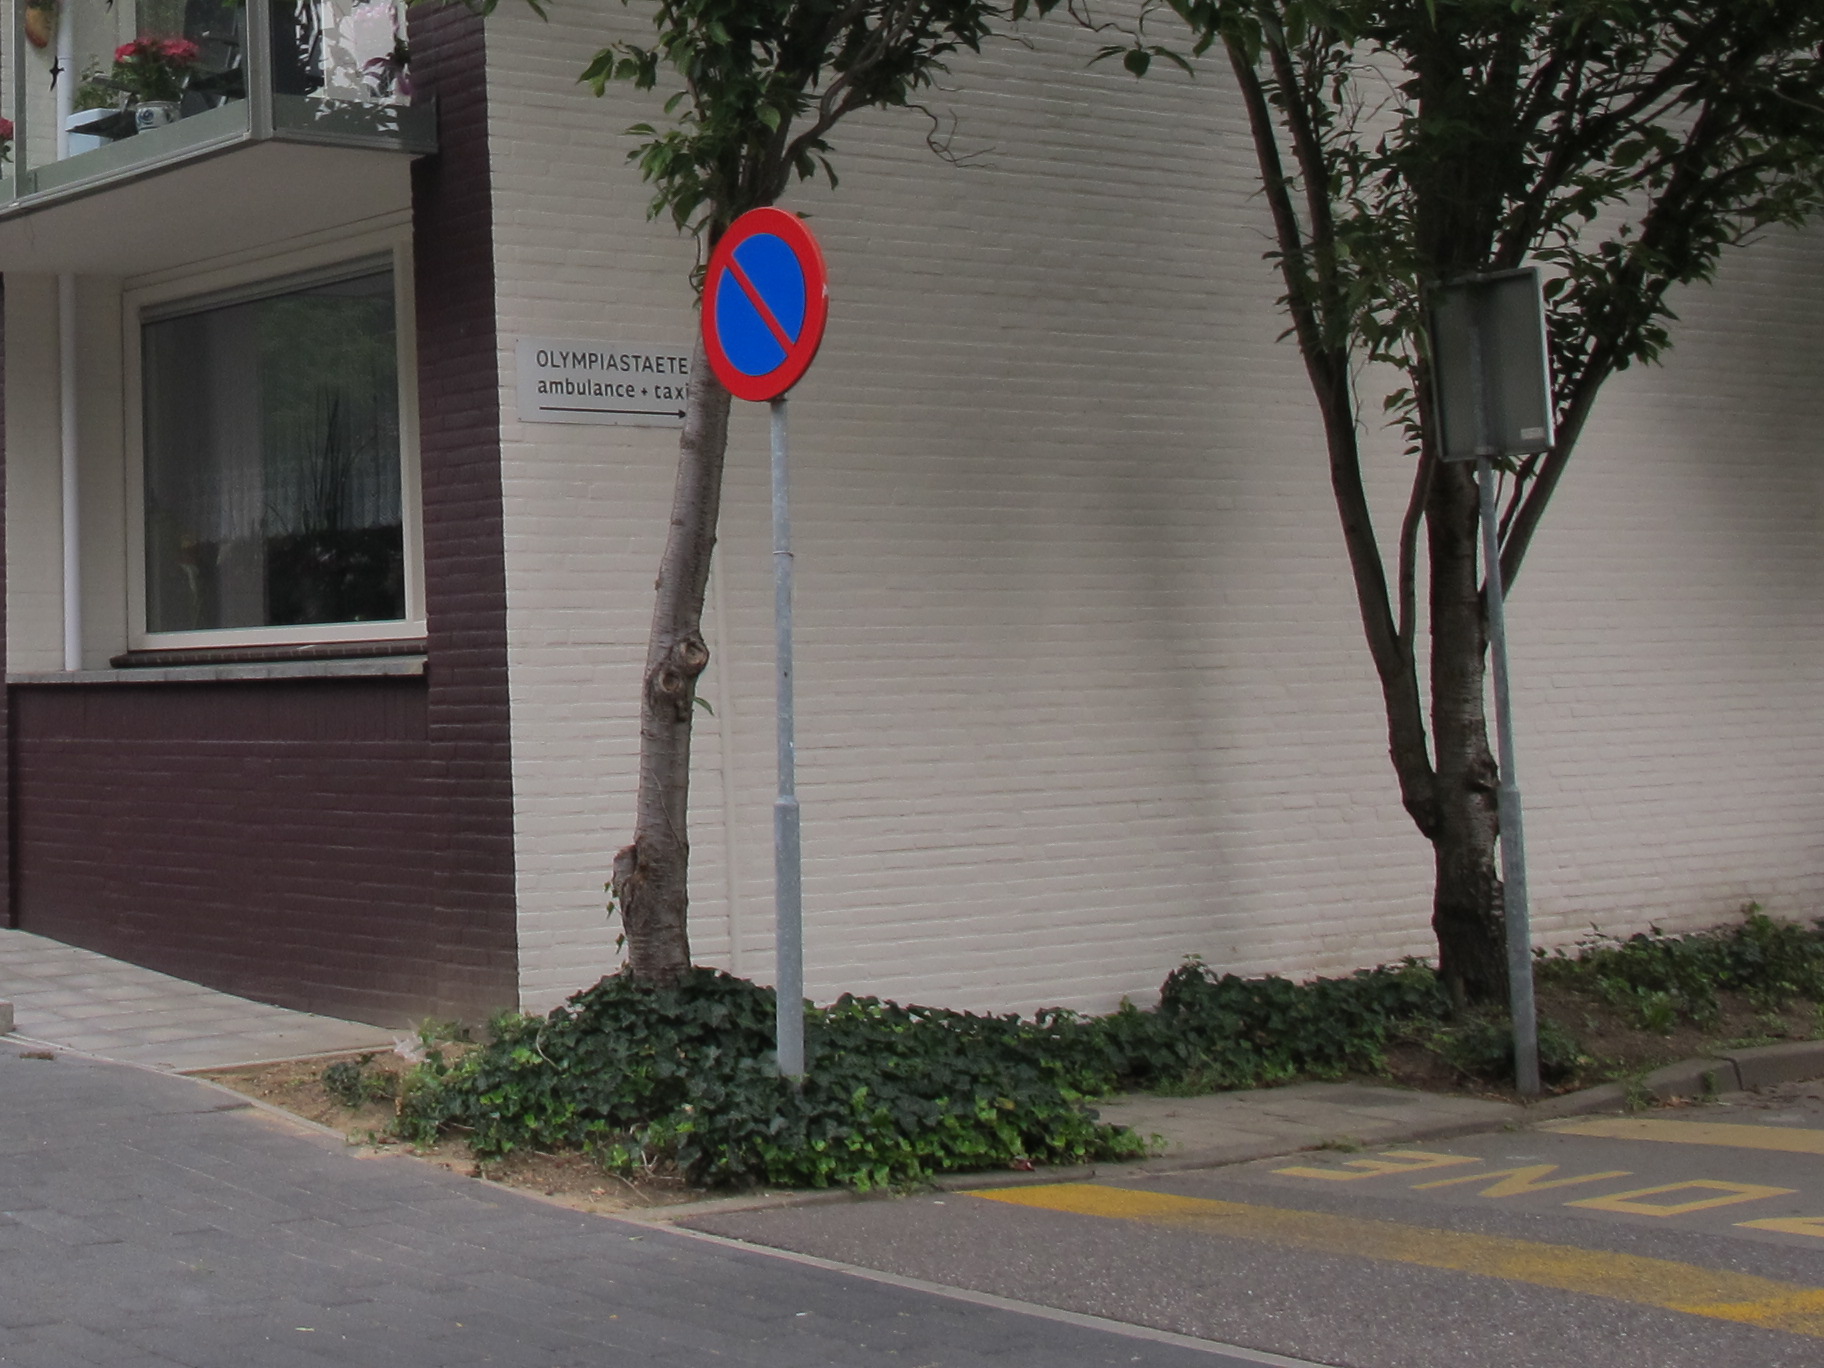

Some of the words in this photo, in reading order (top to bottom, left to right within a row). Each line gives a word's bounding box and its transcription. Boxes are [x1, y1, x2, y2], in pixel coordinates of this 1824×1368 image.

[536, 348, 688, 375] OLYMPIASTAETE
[537, 377, 635, 399] ambulance
[655, 382, 690, 401] taxi
